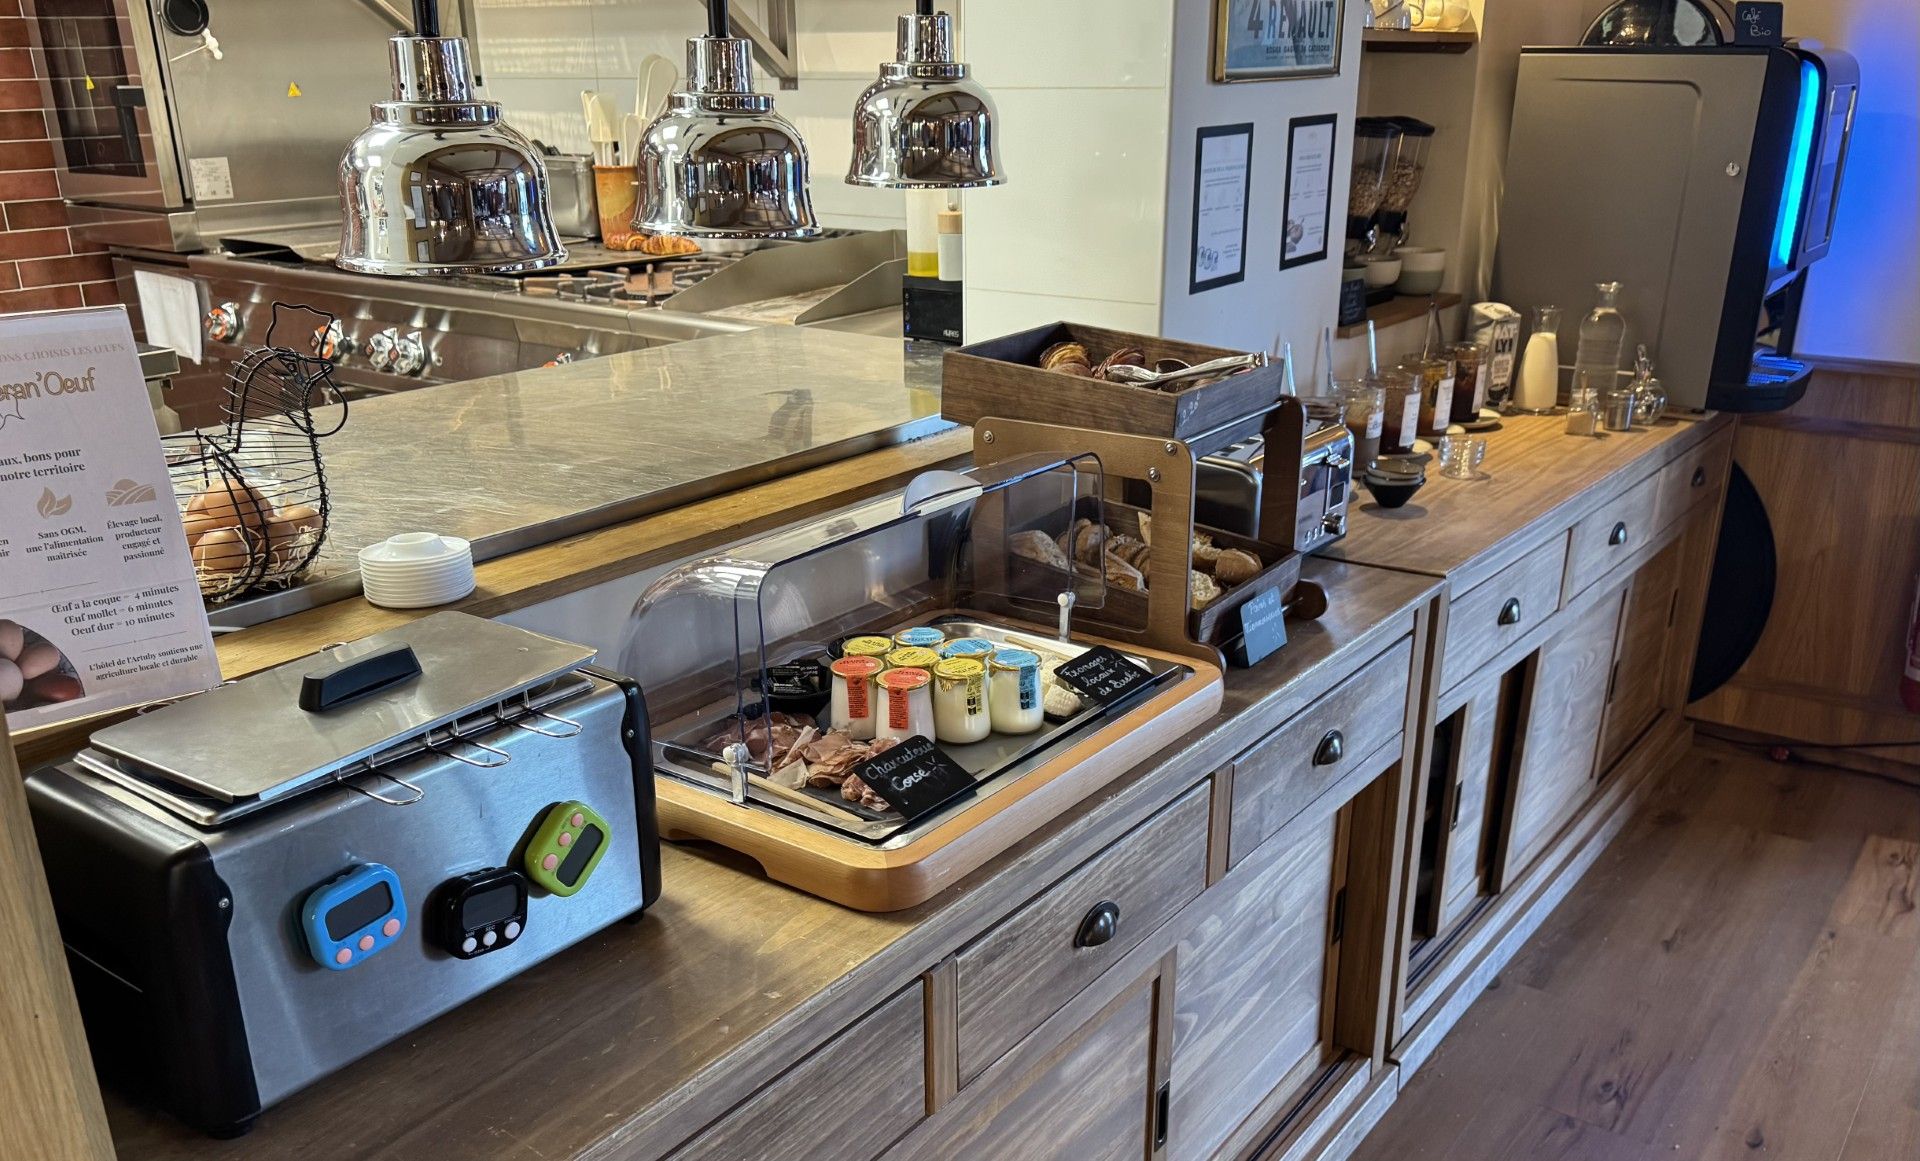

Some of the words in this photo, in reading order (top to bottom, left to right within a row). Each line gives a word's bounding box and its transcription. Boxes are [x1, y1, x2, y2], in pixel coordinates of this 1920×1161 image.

[1247, 0, 1263, 39] 4
[1267, 0, 1334, 39] RENAULT
[1750, 24, 1772, 37] Bio
[23, 347, 71, 361] CHOISIS
[23, 452, 52, 463] bons
[54, 449, 81, 461] pour
[0, 470, 31, 482] notre
[33, 462, 86, 477] territoire
[106, 519, 139, 529] Élevage
[38, 530, 60, 540] Sans
[115, 526, 162, 541] producteur
[25, 544, 43, 554] une
[44, 535, 104, 552] l'alimentation
[122, 537, 151, 550] engagé
[152, 537, 161, 545] et
[47, 548, 88, 562] maîtrisée
[123, 546, 165, 563] passionné
[81, 599, 92, 608] la
[93, 594, 121, 607] coque
[134, 592, 140, 600] 4
[142, 584, 180, 598] minutes
[87, 606, 118, 621] mollet
[127, 604, 134, 613] 6
[135, 598, 174, 613] minutes
[71, 624, 96, 637] Oeuf
[97, 621, 115, 633] dur
[125, 618, 136, 627] 10
[137, 610, 176, 625] minutes
[89, 657, 115, 672] L'hôtel
[116, 657, 126, 666] de
[158, 645, 189, 658] soutiens
[189, 643, 204, 652] une
[95, 667, 138, 681] agriculture
[139, 661, 161, 673] locale
[162, 659, 169, 668] et
[170, 653, 199, 666] durable
[1081, 666, 1116, 688] locaux
[1098, 685, 1113, 696] de
[891, 767, 930, 791] Corse
